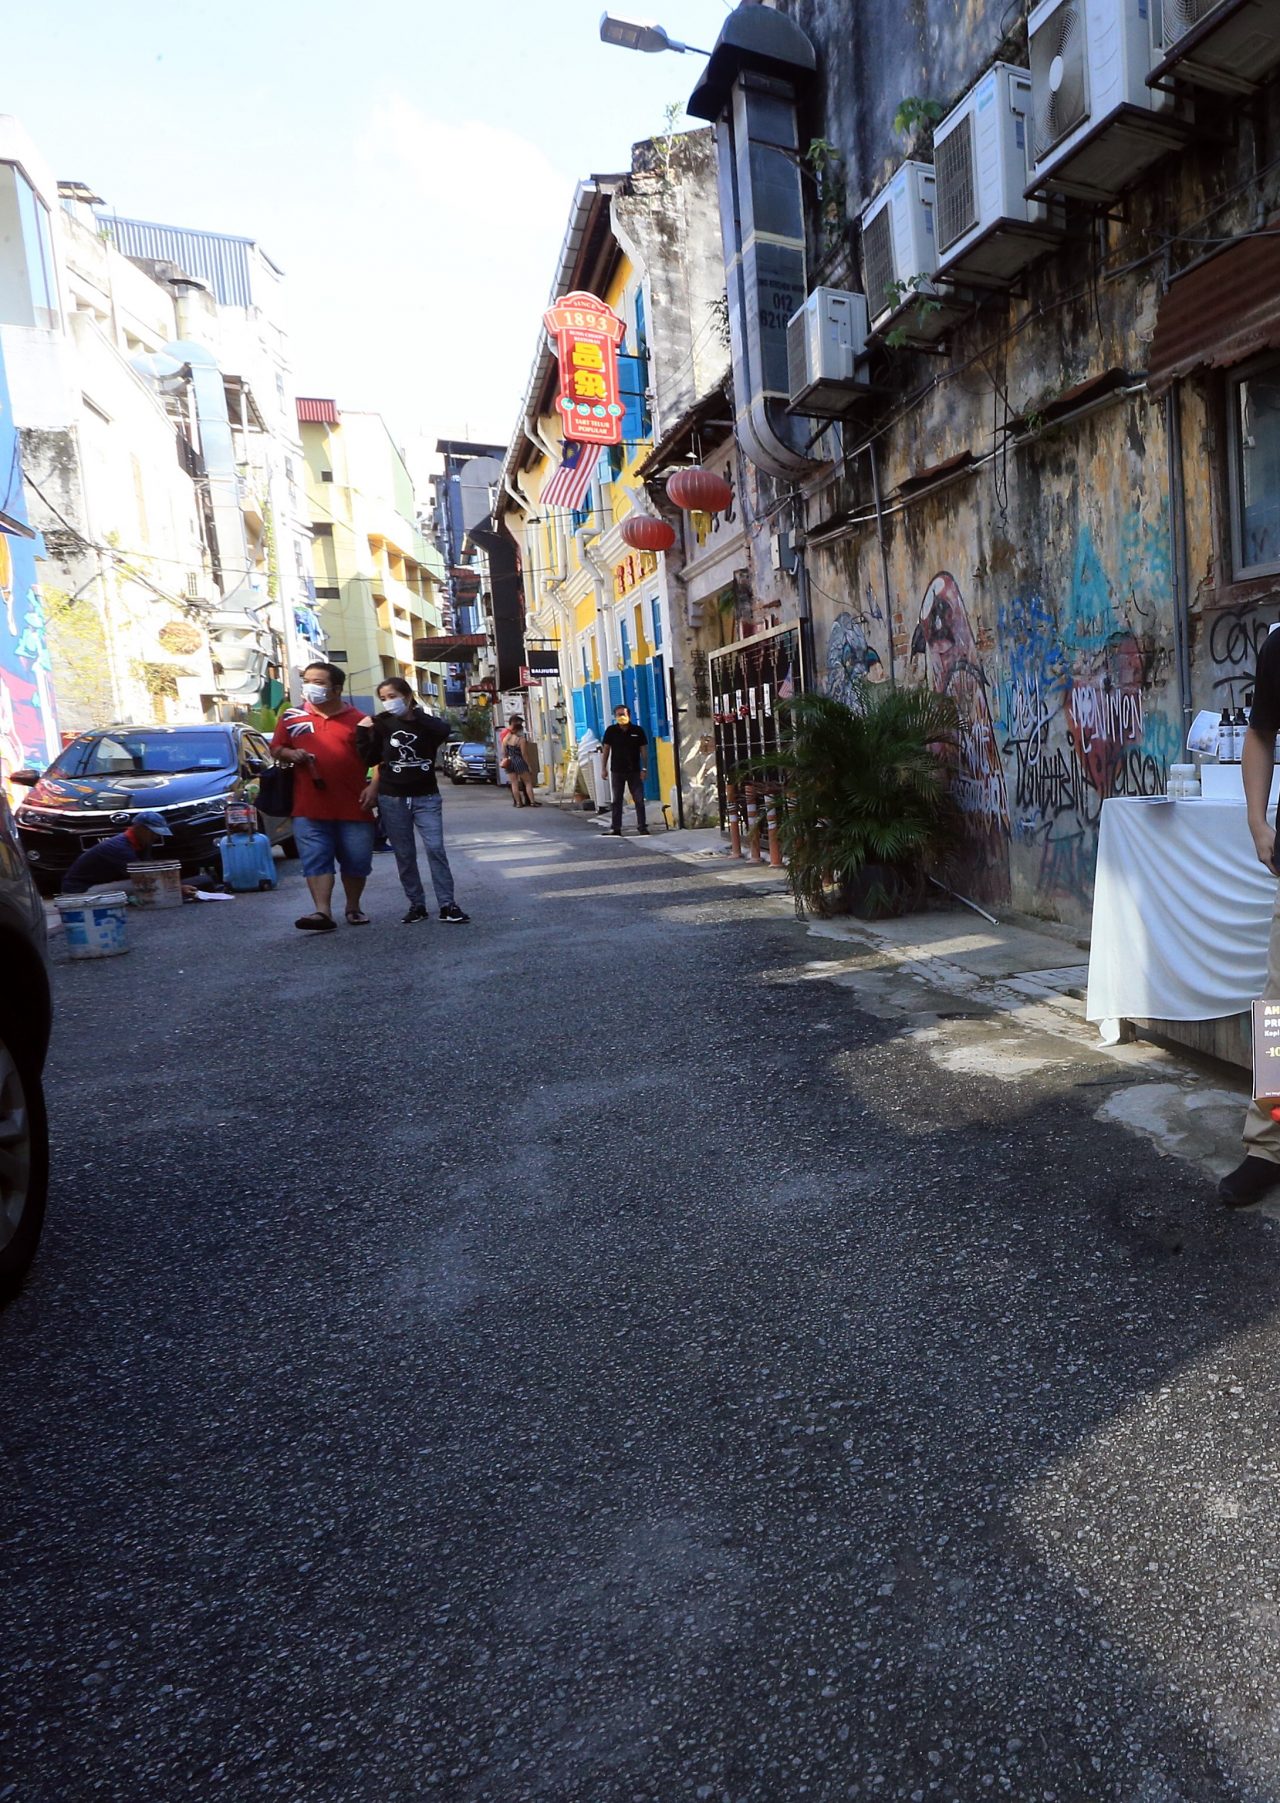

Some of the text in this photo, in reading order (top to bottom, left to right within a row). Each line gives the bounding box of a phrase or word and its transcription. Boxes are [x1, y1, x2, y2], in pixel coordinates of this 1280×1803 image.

[564, 311, 608, 330] 1893
[1264, 1005, 1280, 1015] AH
[1264, 1030, 1280, 1038] Kopi
